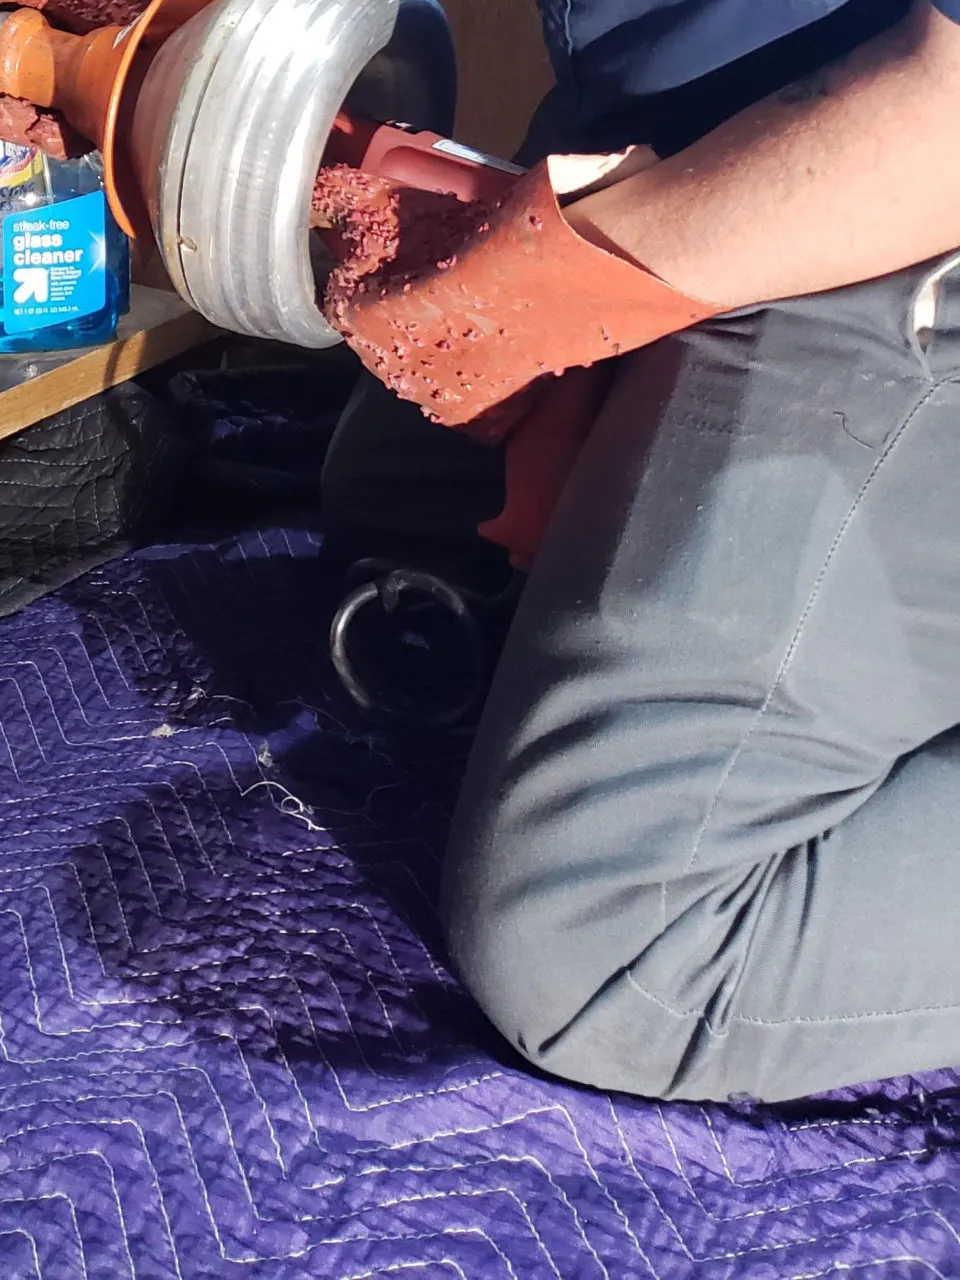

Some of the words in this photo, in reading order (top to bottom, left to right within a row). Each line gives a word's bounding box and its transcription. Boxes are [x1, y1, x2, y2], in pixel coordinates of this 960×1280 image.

[13, 220, 70, 232] streak-free
[13, 232, 63, 252] glass
[13, 249, 84, 265] cleaner
